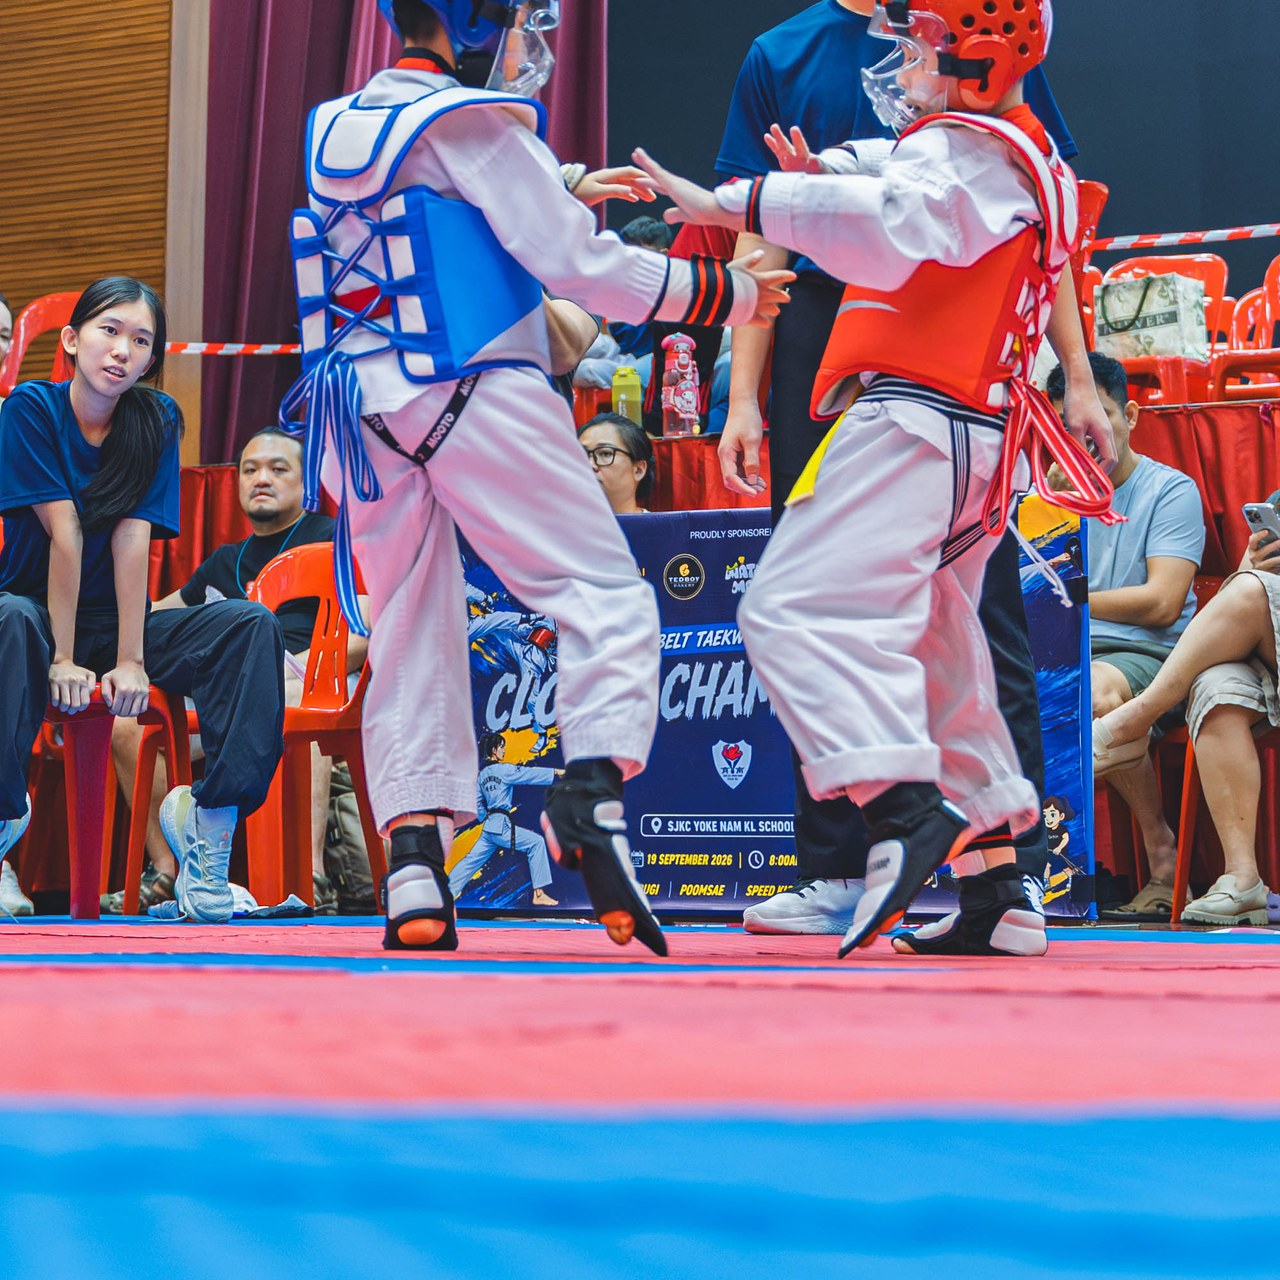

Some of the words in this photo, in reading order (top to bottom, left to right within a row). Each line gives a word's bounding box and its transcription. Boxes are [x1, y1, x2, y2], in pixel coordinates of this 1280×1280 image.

[426, 412, 454, 449] MOOTO
[689, 530, 727, 540] PROUDLY
[659, 631, 693, 650] BELT
[696, 628, 743, 648] TAEKW
[485, 672, 559, 733] CLO
[667, 820, 692, 832] SJKC
[693, 820, 718, 832] YOKE
[719, 820, 742, 832] NAM
[743, 820, 756, 832] KL
[647, 853, 657, 865] 19
[658, 853, 709, 866] SEPTEMBER
[710, 854, 733, 866] 2026
[679, 884, 726, 897] POOMSAE
[745, 884, 775, 897] SPEED
